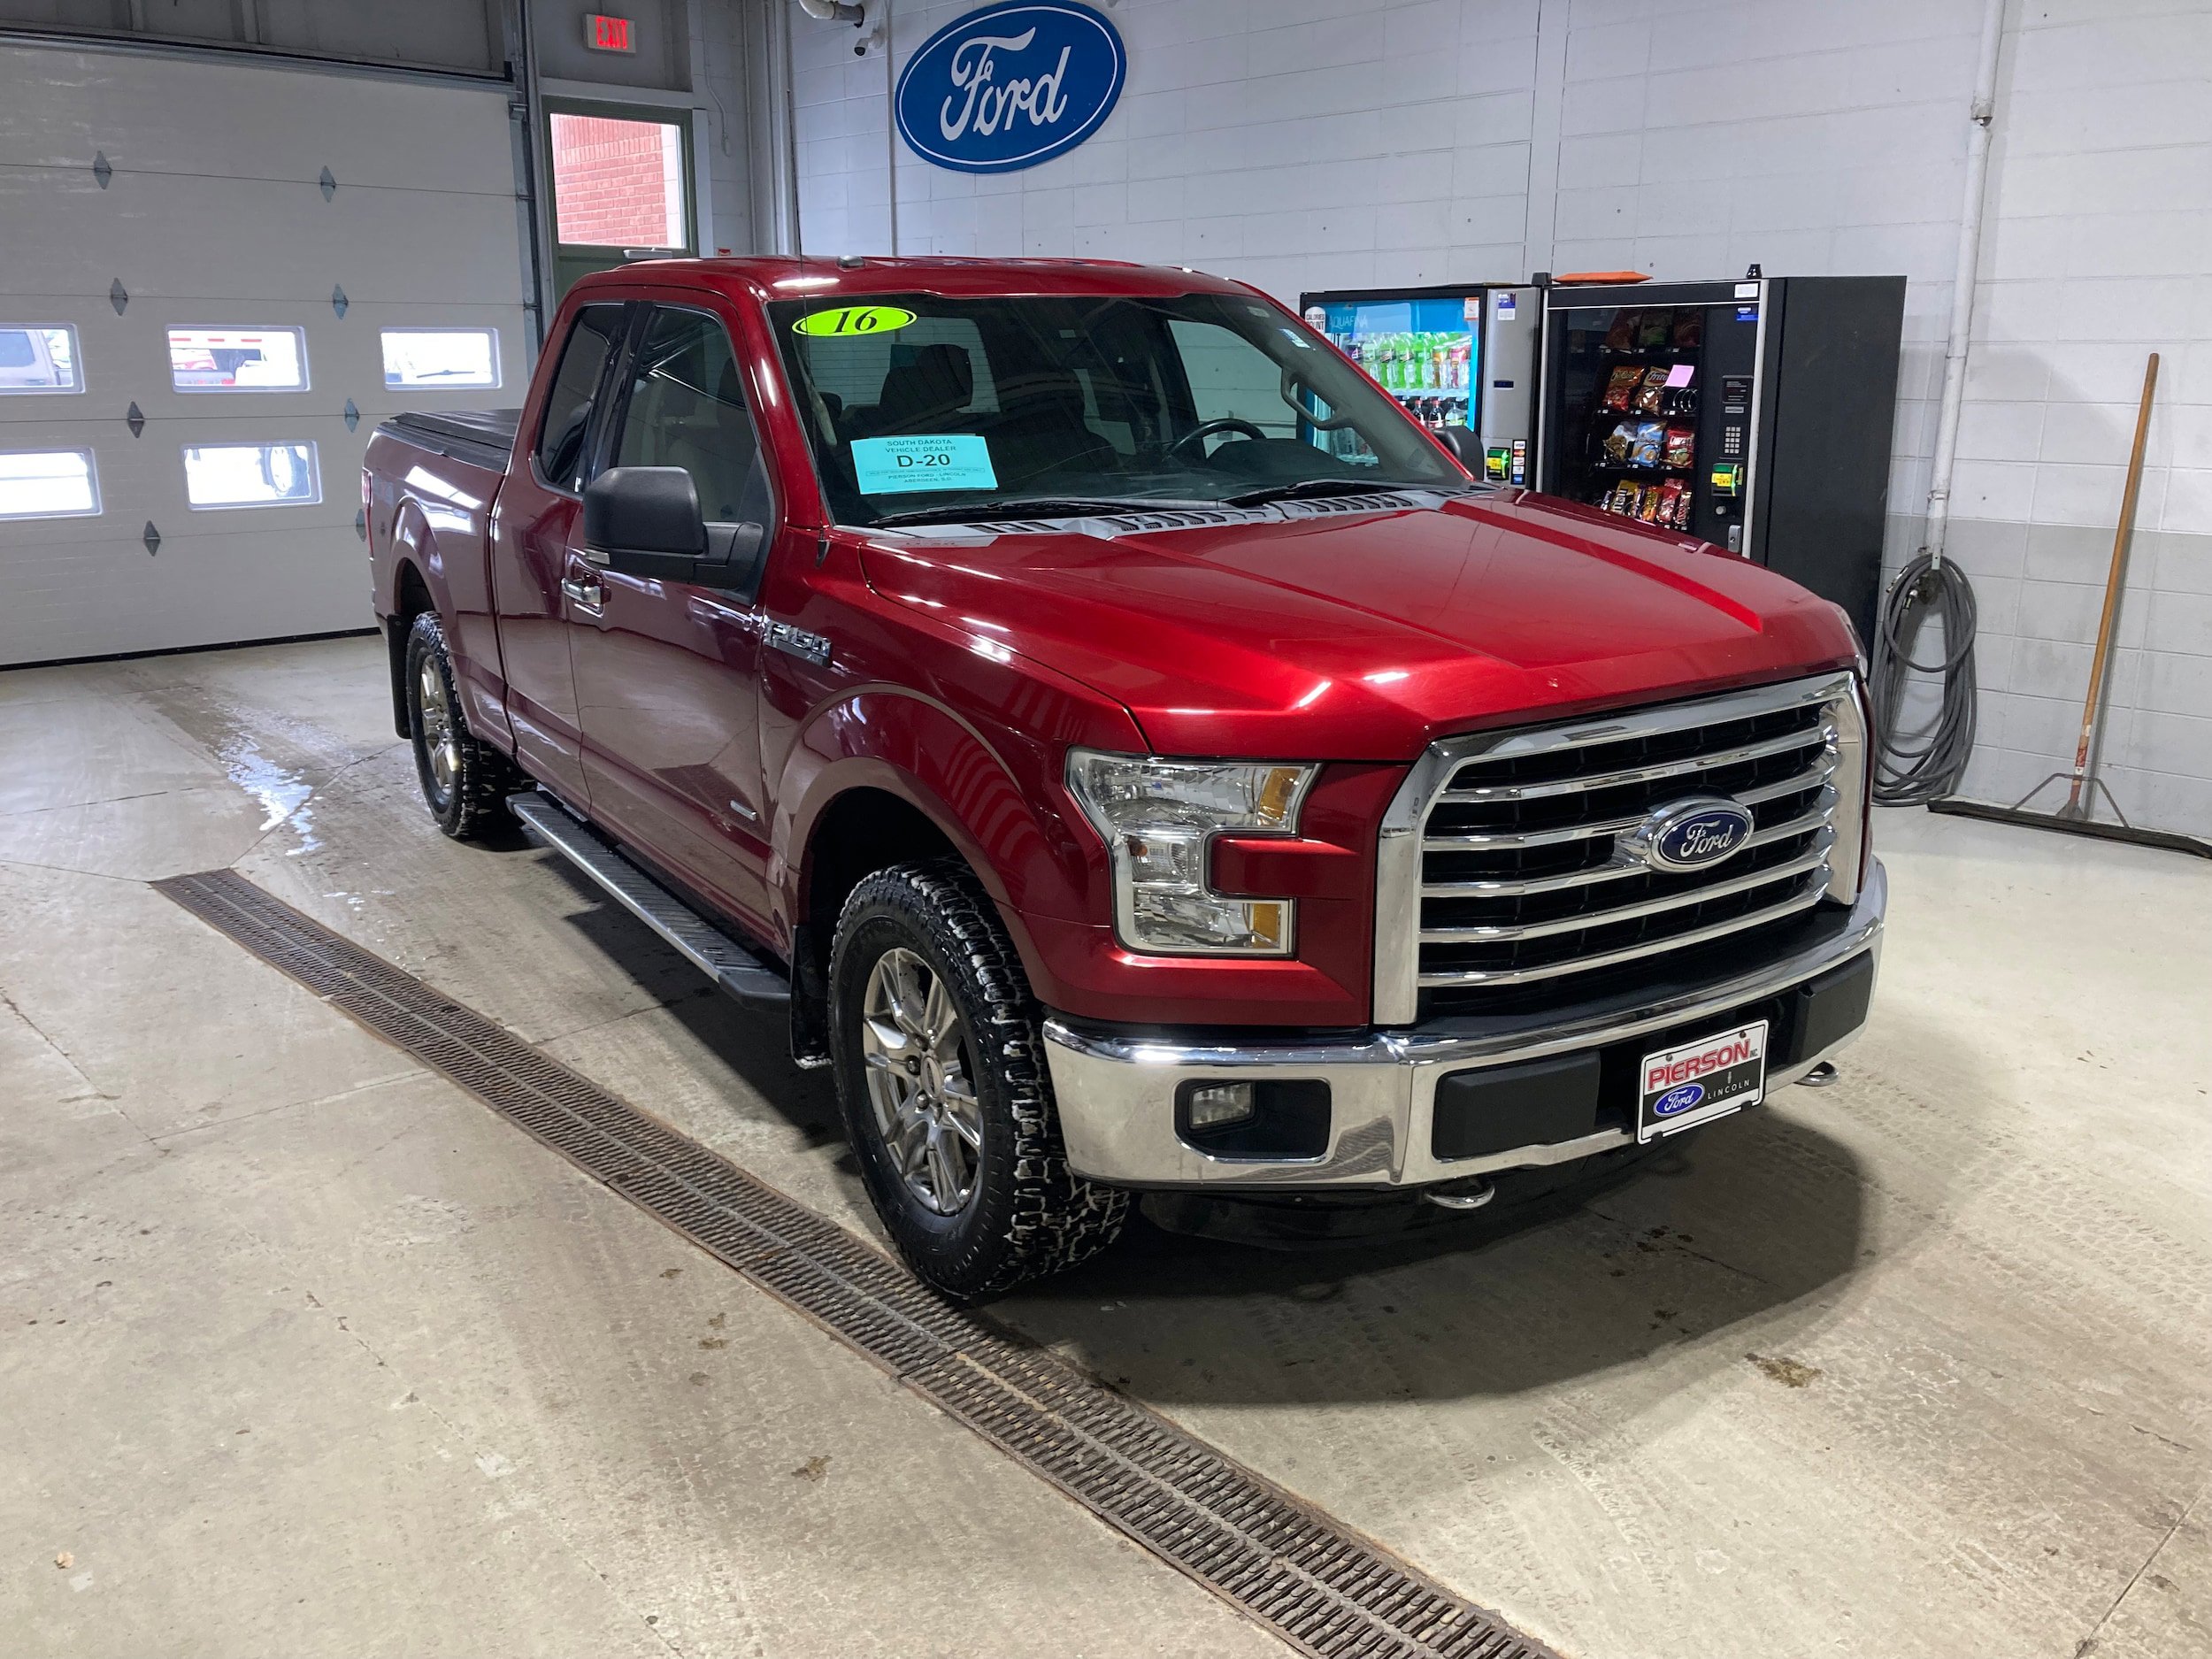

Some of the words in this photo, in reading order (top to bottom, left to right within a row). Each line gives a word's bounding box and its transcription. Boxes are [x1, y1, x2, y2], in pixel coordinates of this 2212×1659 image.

[595, 15, 627, 50] EXIT
[940, 27, 1071, 142] Ford
[828, 308, 879, 334] 16
[896, 454, 950, 467] D-20
[1680, 819, 1733, 857] Ford
[1647, 1039, 1751, 1091] PIERSON
[1663, 1089, 1695, 1111] Ford
[1707, 1079, 1750, 1100] LINCOLN
